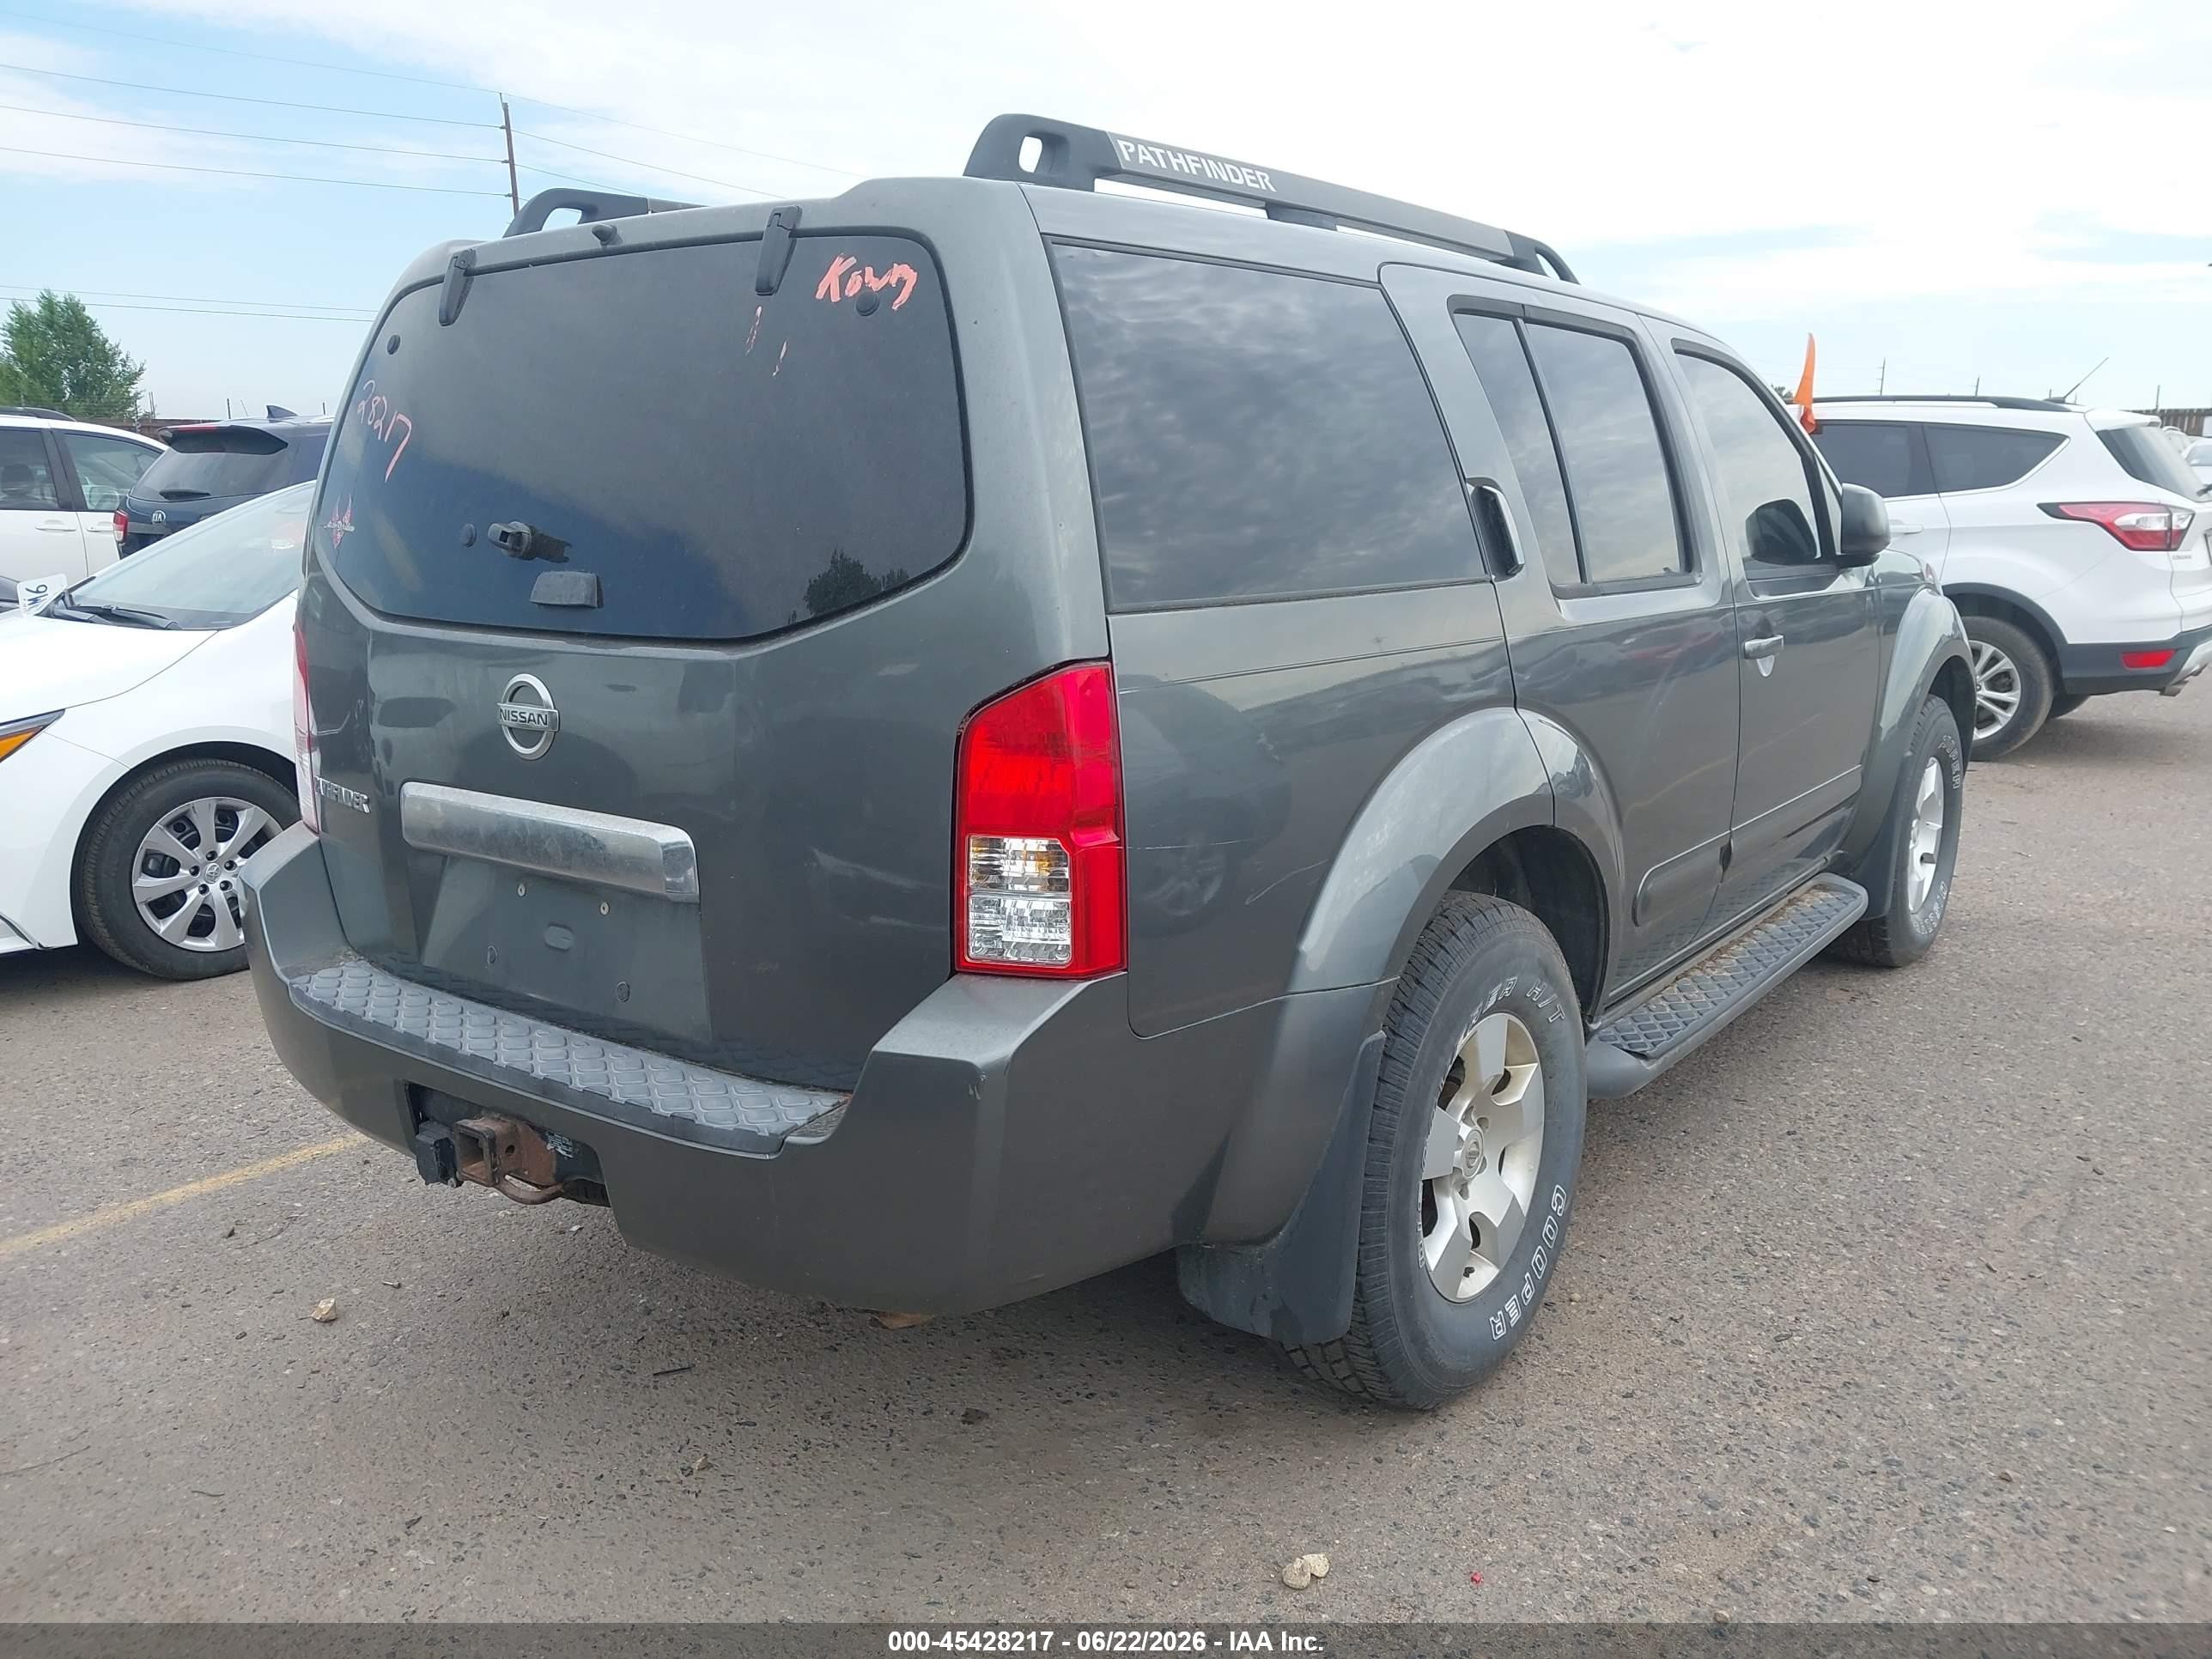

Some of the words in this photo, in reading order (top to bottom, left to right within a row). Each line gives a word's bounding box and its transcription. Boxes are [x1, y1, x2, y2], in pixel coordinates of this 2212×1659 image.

[1116, 139, 1277, 193] PATHFINDER
[499, 708, 548, 726] NISSAN
[1526, 978, 1565, 1024] H/T
[1489, 1184, 1566, 1341] COOPER
